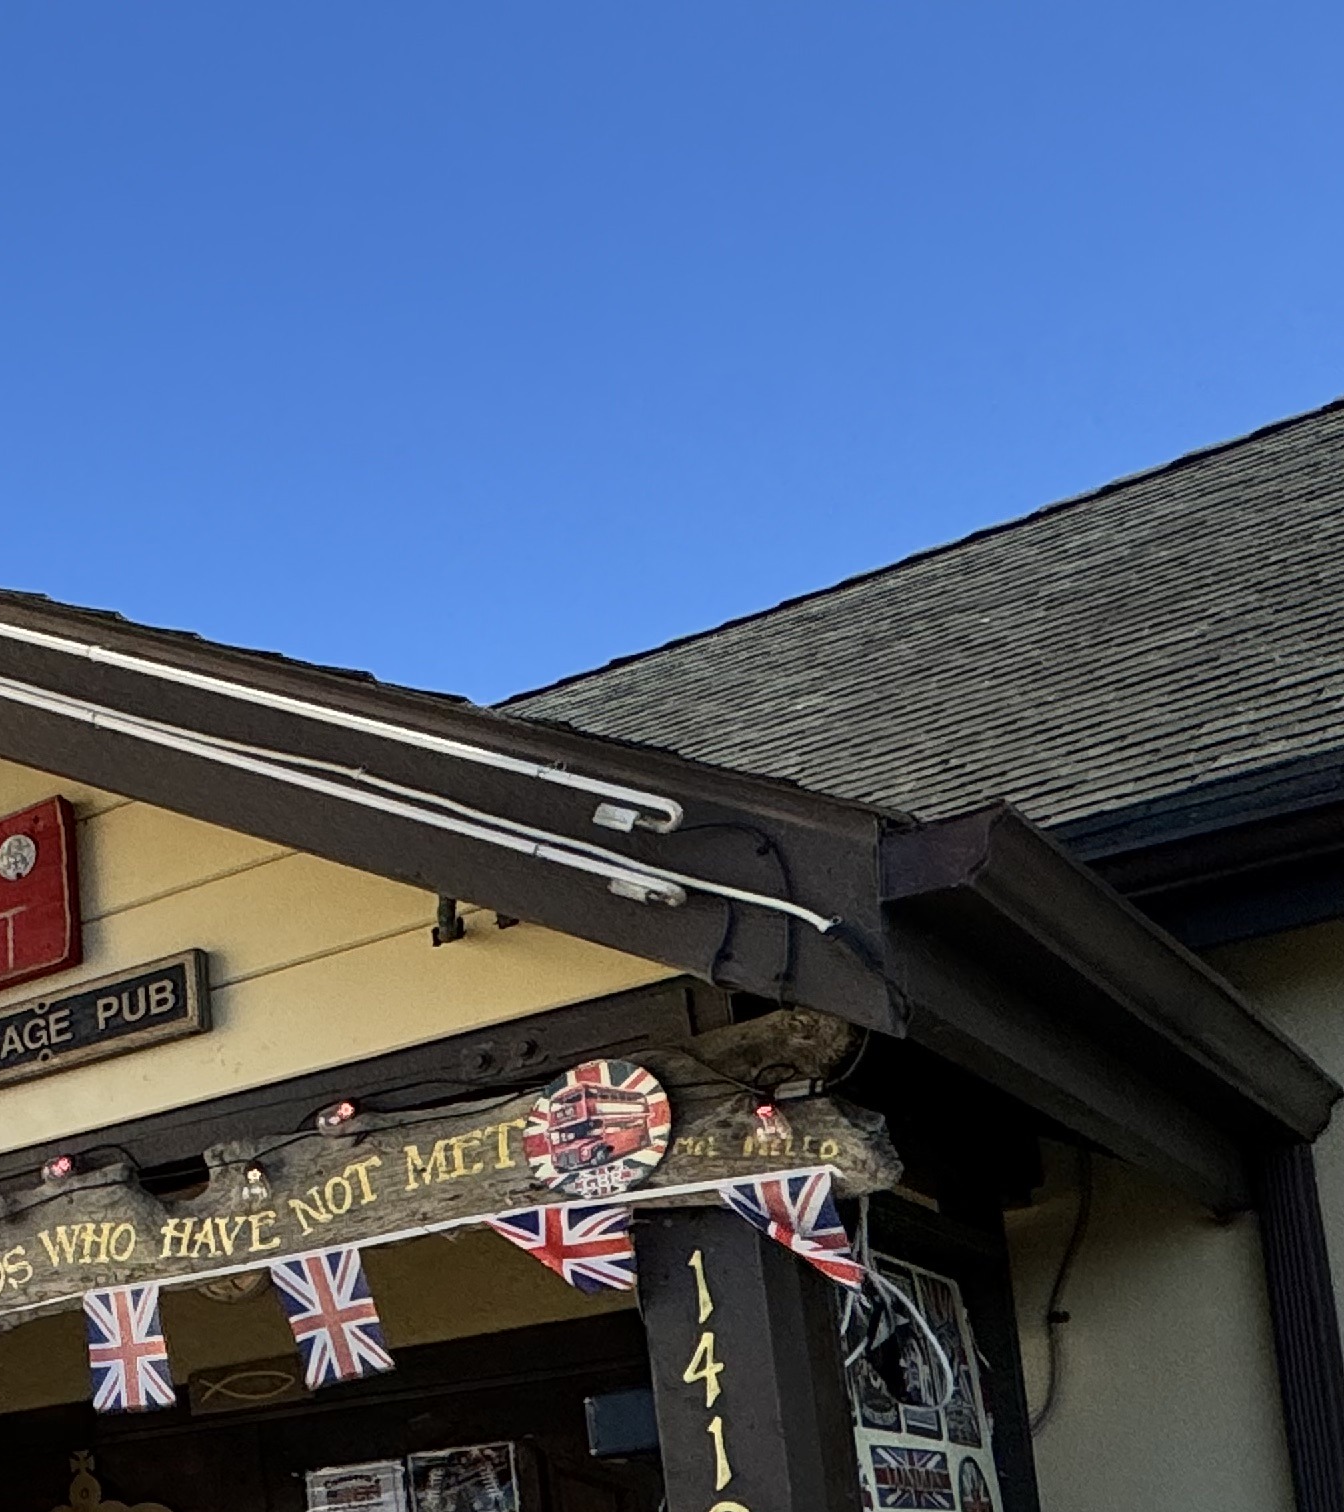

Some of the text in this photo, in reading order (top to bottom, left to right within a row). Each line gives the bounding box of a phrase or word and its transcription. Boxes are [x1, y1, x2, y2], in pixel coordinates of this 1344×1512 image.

[96, 980, 177, 1031] PUB
[38, 1222, 137, 1270] WHO
[159, 1209, 281, 1259] HAVE
[288, 1155, 385, 1234] NOT
[403, 1118, 526, 1191] MET
